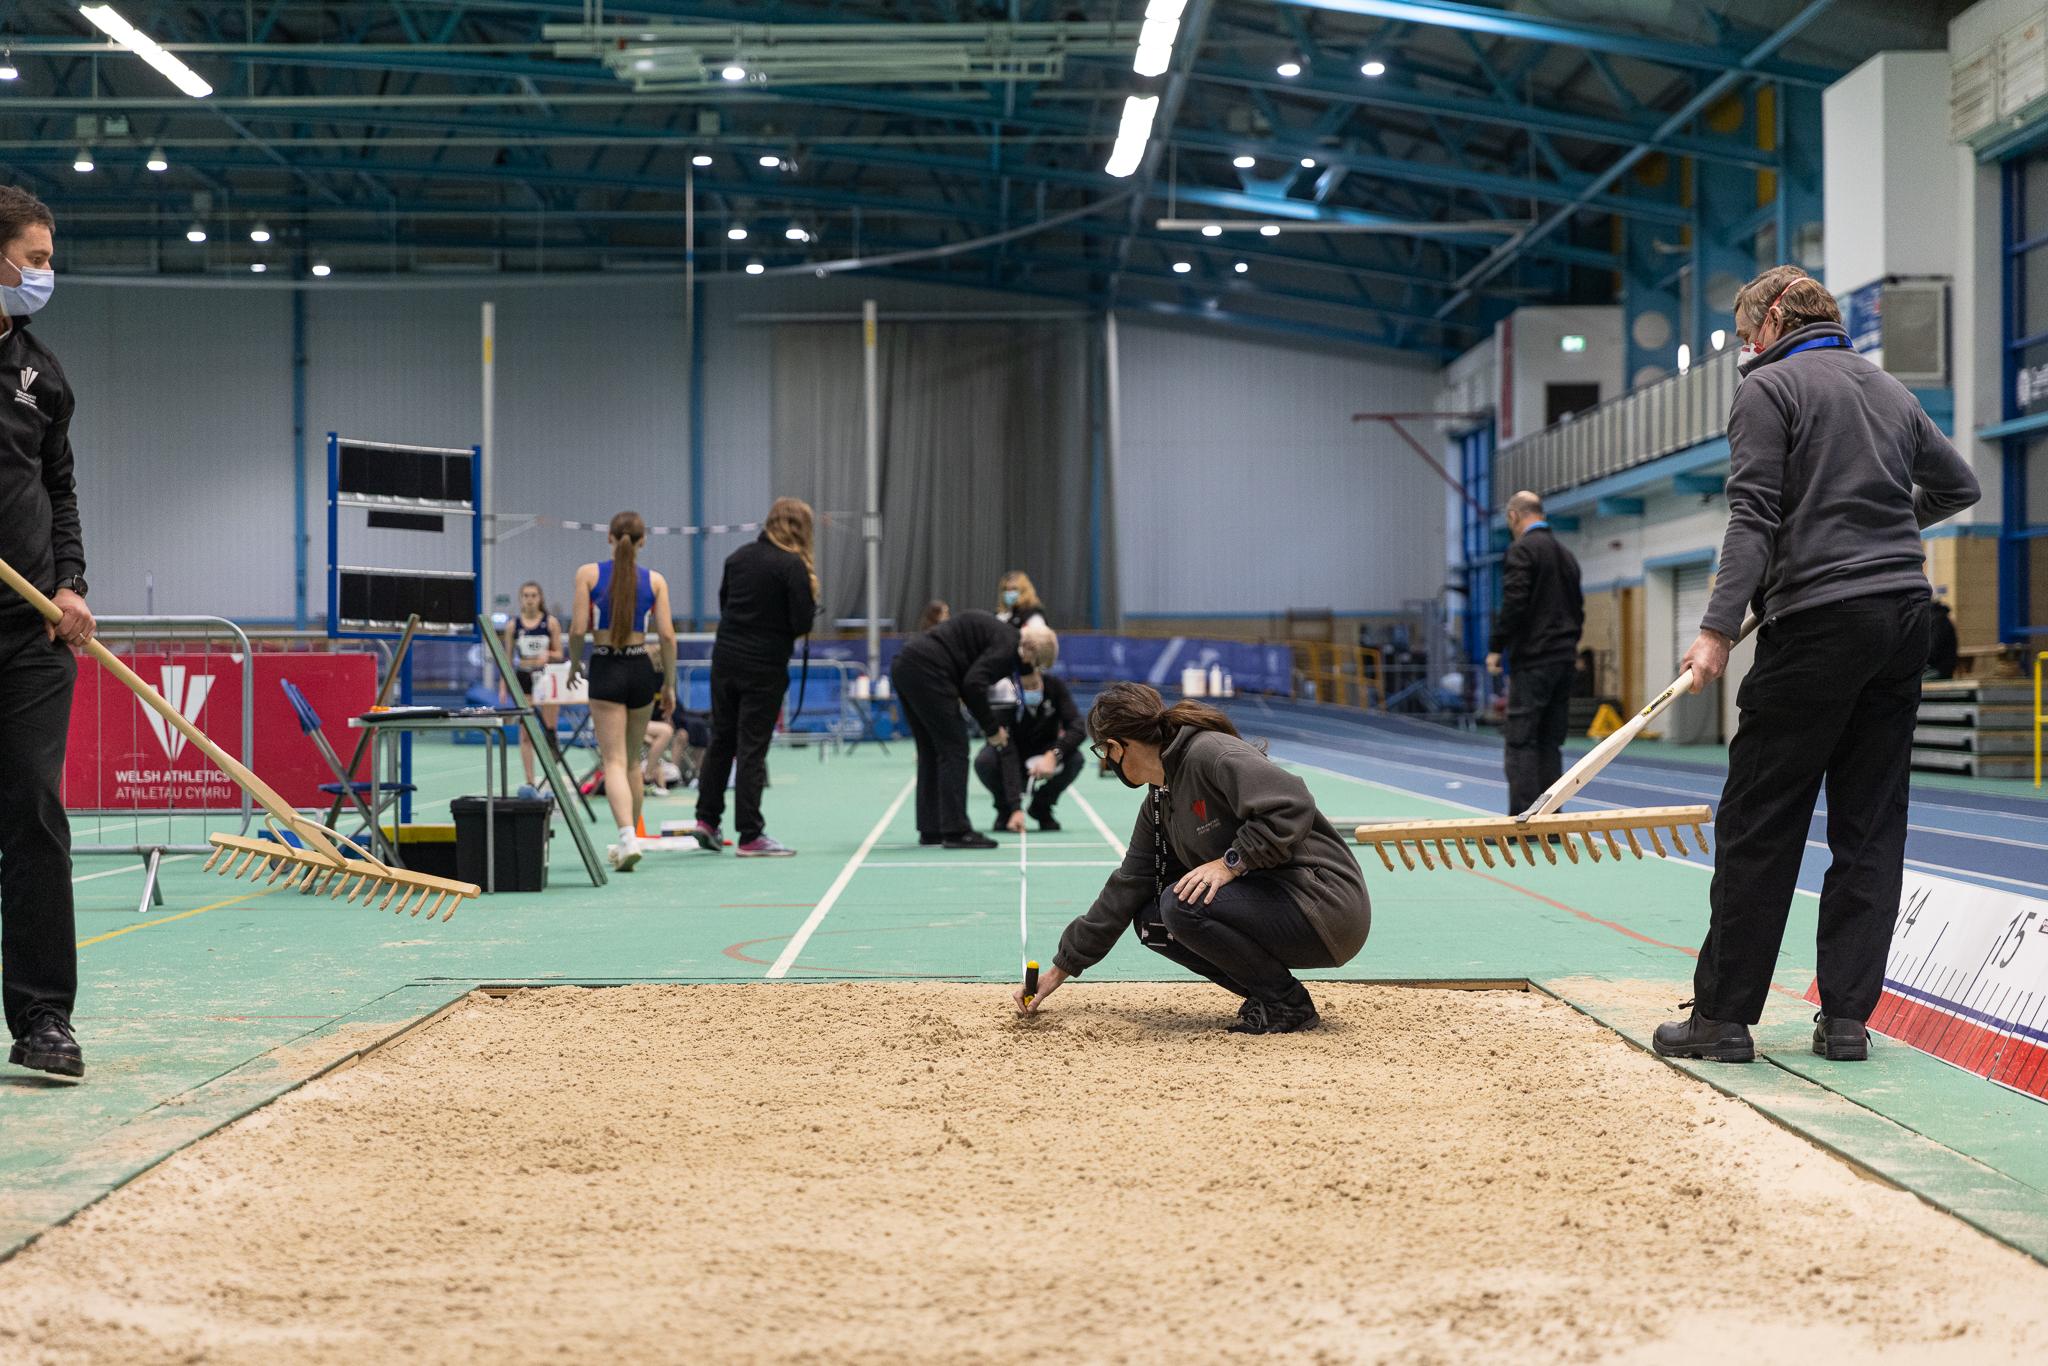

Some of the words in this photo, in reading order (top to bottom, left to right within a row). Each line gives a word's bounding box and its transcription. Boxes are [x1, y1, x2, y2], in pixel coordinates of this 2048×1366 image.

[115, 770, 161, 783] WELSH
[162, 770, 231, 783] ATHLETICS
[115, 786, 183, 800] ATHLETAU
[185, 786, 232, 800] CYMRU
[1893, 886, 1933, 939] 14
[1991, 910, 2038, 969] 15
